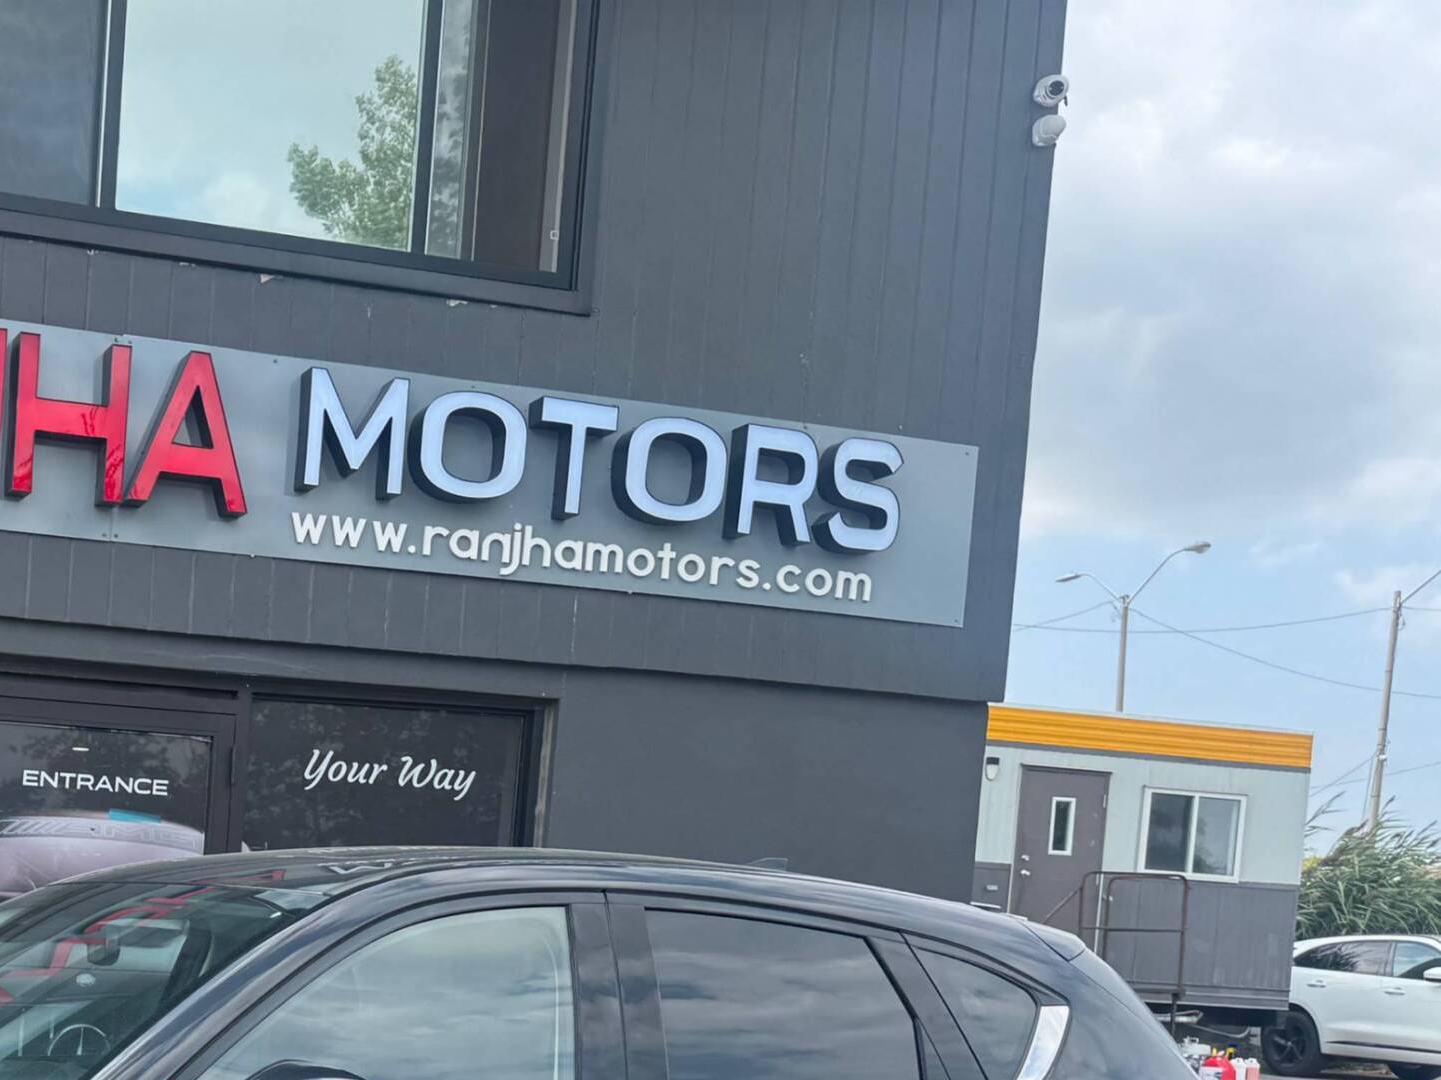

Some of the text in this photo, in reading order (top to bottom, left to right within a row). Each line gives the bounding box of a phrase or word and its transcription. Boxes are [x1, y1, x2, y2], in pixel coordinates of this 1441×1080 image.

[293, 366, 905, 553] MOTORS
[291, 511, 873, 603] www.ranjhamotors.com
[22, 769, 170, 796] ENTRANCE
[303, 749, 477, 801] Your Way
